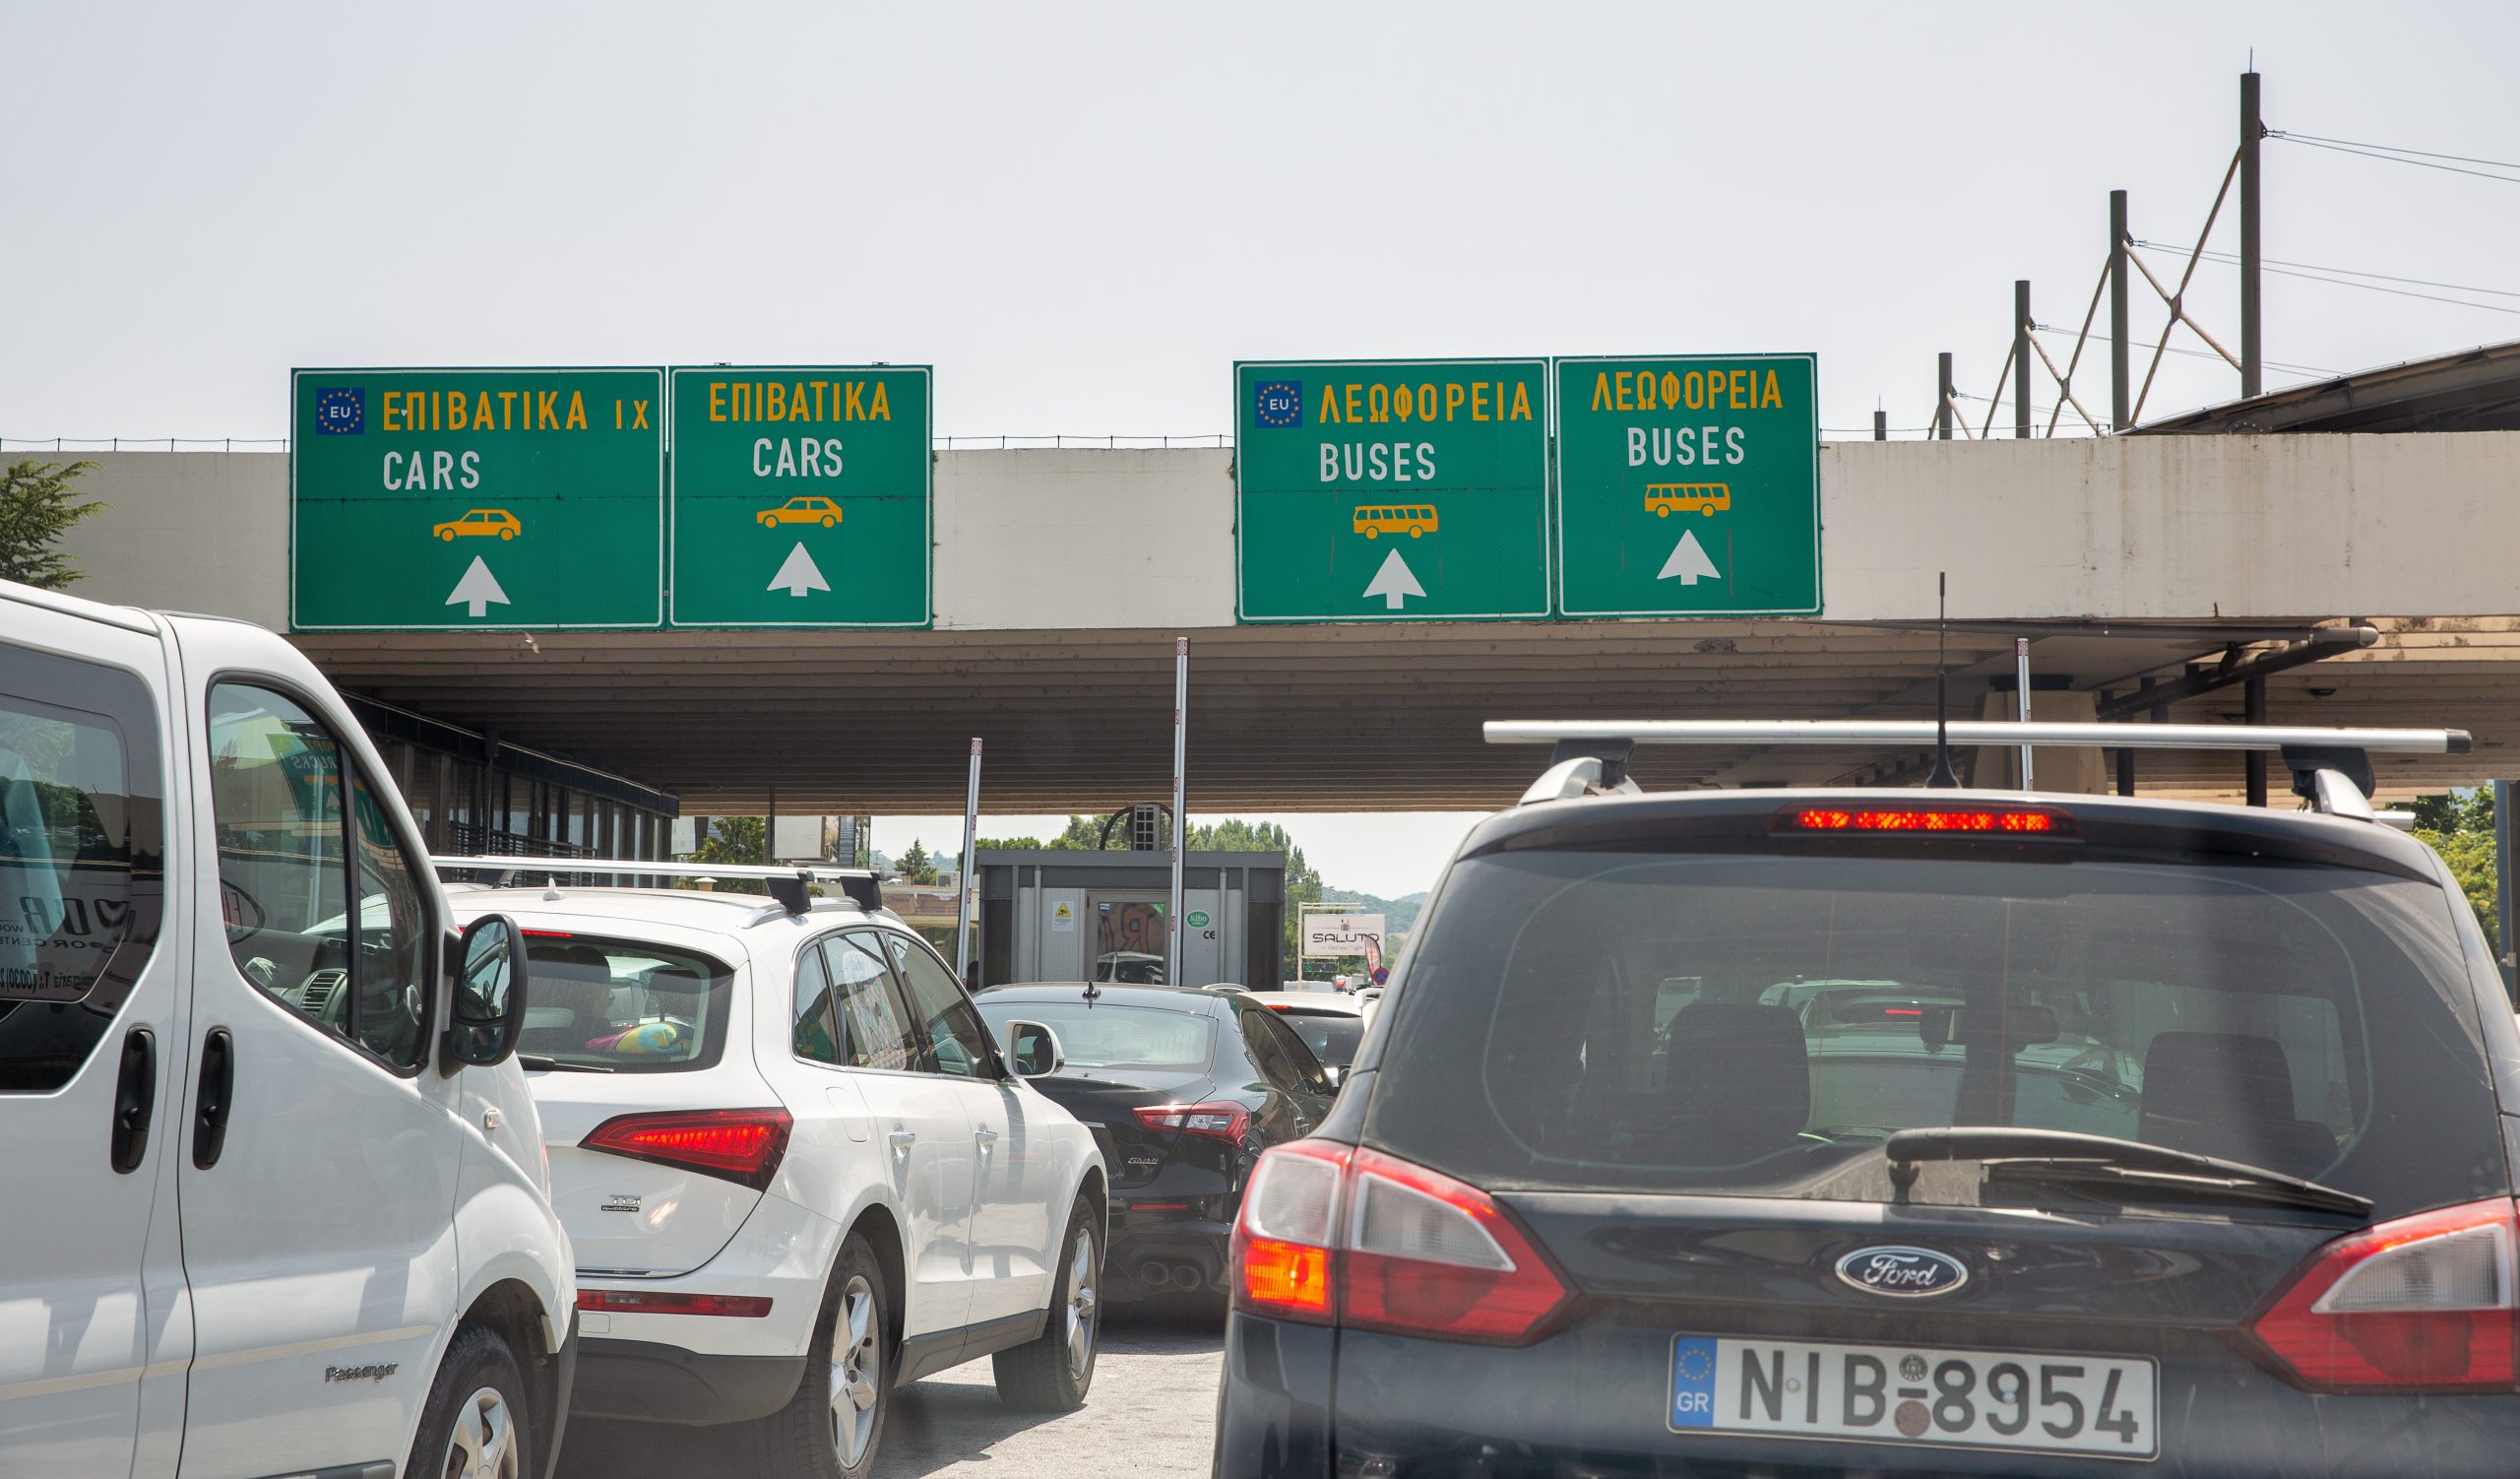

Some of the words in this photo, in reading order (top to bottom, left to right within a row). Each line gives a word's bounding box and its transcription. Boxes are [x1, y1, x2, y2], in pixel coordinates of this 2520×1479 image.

[710, 381, 891, 422] ΕΠΙΒΑΤΙΚΑ
[1270, 398, 1290, 411] EU
[1319, 382, 1532, 423] ΛΕΩΦΟΡΕΙΑ
[1592, 369, 1783, 411] ΛΕΩΦΟΡΕΙΑ
[330, 406, 350, 418] EU
[383, 390, 588, 431] ΕΠΙΒΑΤΙΚΑ
[753, 437, 843, 478] CARS
[1320, 442, 1436, 482] BUSES
[1627, 425, 1744, 467] BUSES
[383, 450, 480, 490] CARS
[1202, 930, 1216, 940] CE
[1862, 1254, 1938, 1286] Ford
[324, 1362, 400, 1383] Passenger
[1676, 1391, 1710, 1413] GR
